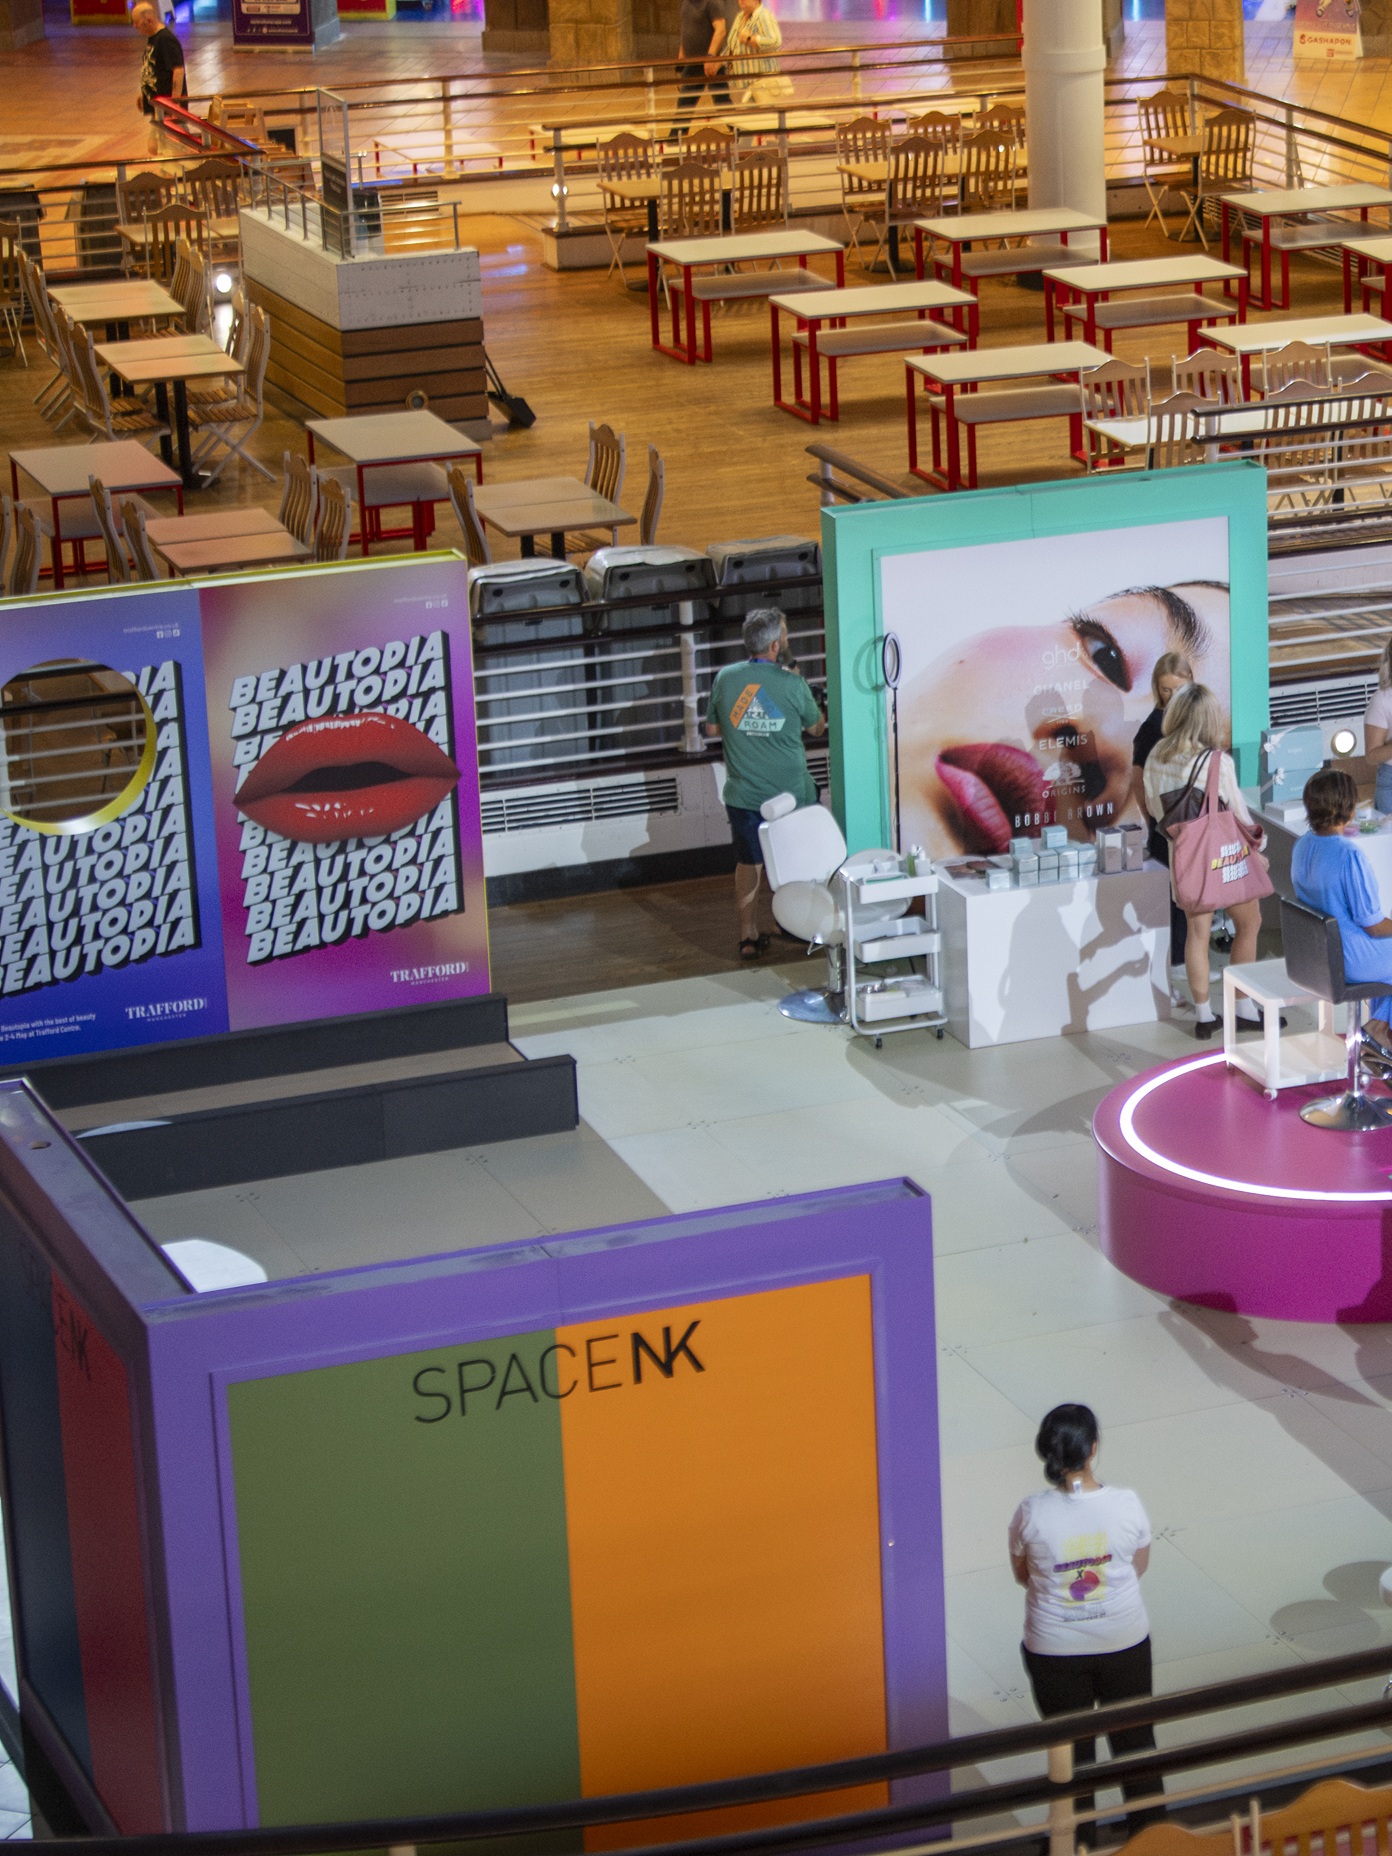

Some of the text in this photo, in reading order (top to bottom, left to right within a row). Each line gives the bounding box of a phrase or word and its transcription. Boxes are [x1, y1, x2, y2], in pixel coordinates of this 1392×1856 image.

[1307, 36, 1352, 45] GASHAPON
[229, 630, 444, 709] BEAUTOPIA
[1042, 642, 1080, 670] ghd
[231, 658, 446, 738] BEAUTOPIA
[1033, 680, 1090, 695] CHANEL
[744, 721, 778, 730] ROAM
[1039, 734, 1088, 750] ELEMIS
[1015, 802, 1114, 828] BOBBI BROWN
[1042, 785, 1086, 799] ORIGINS
[0, 833, 189, 907] EAUTOPIA
[243, 827, 455, 907] BEAUTOPIA
[0, 861, 191, 937] EAUTOPIA
[245, 854, 456, 935] BEAUTOPIA
[0, 889, 193, 965] EAUTOPIA
[247, 882, 458, 963] BEAUTOPIA
[0, 917, 195, 994] EAUTOPIA
[390, 962, 466, 982] TRAFFORD
[125, 998, 204, 1020] TRAFFORD
